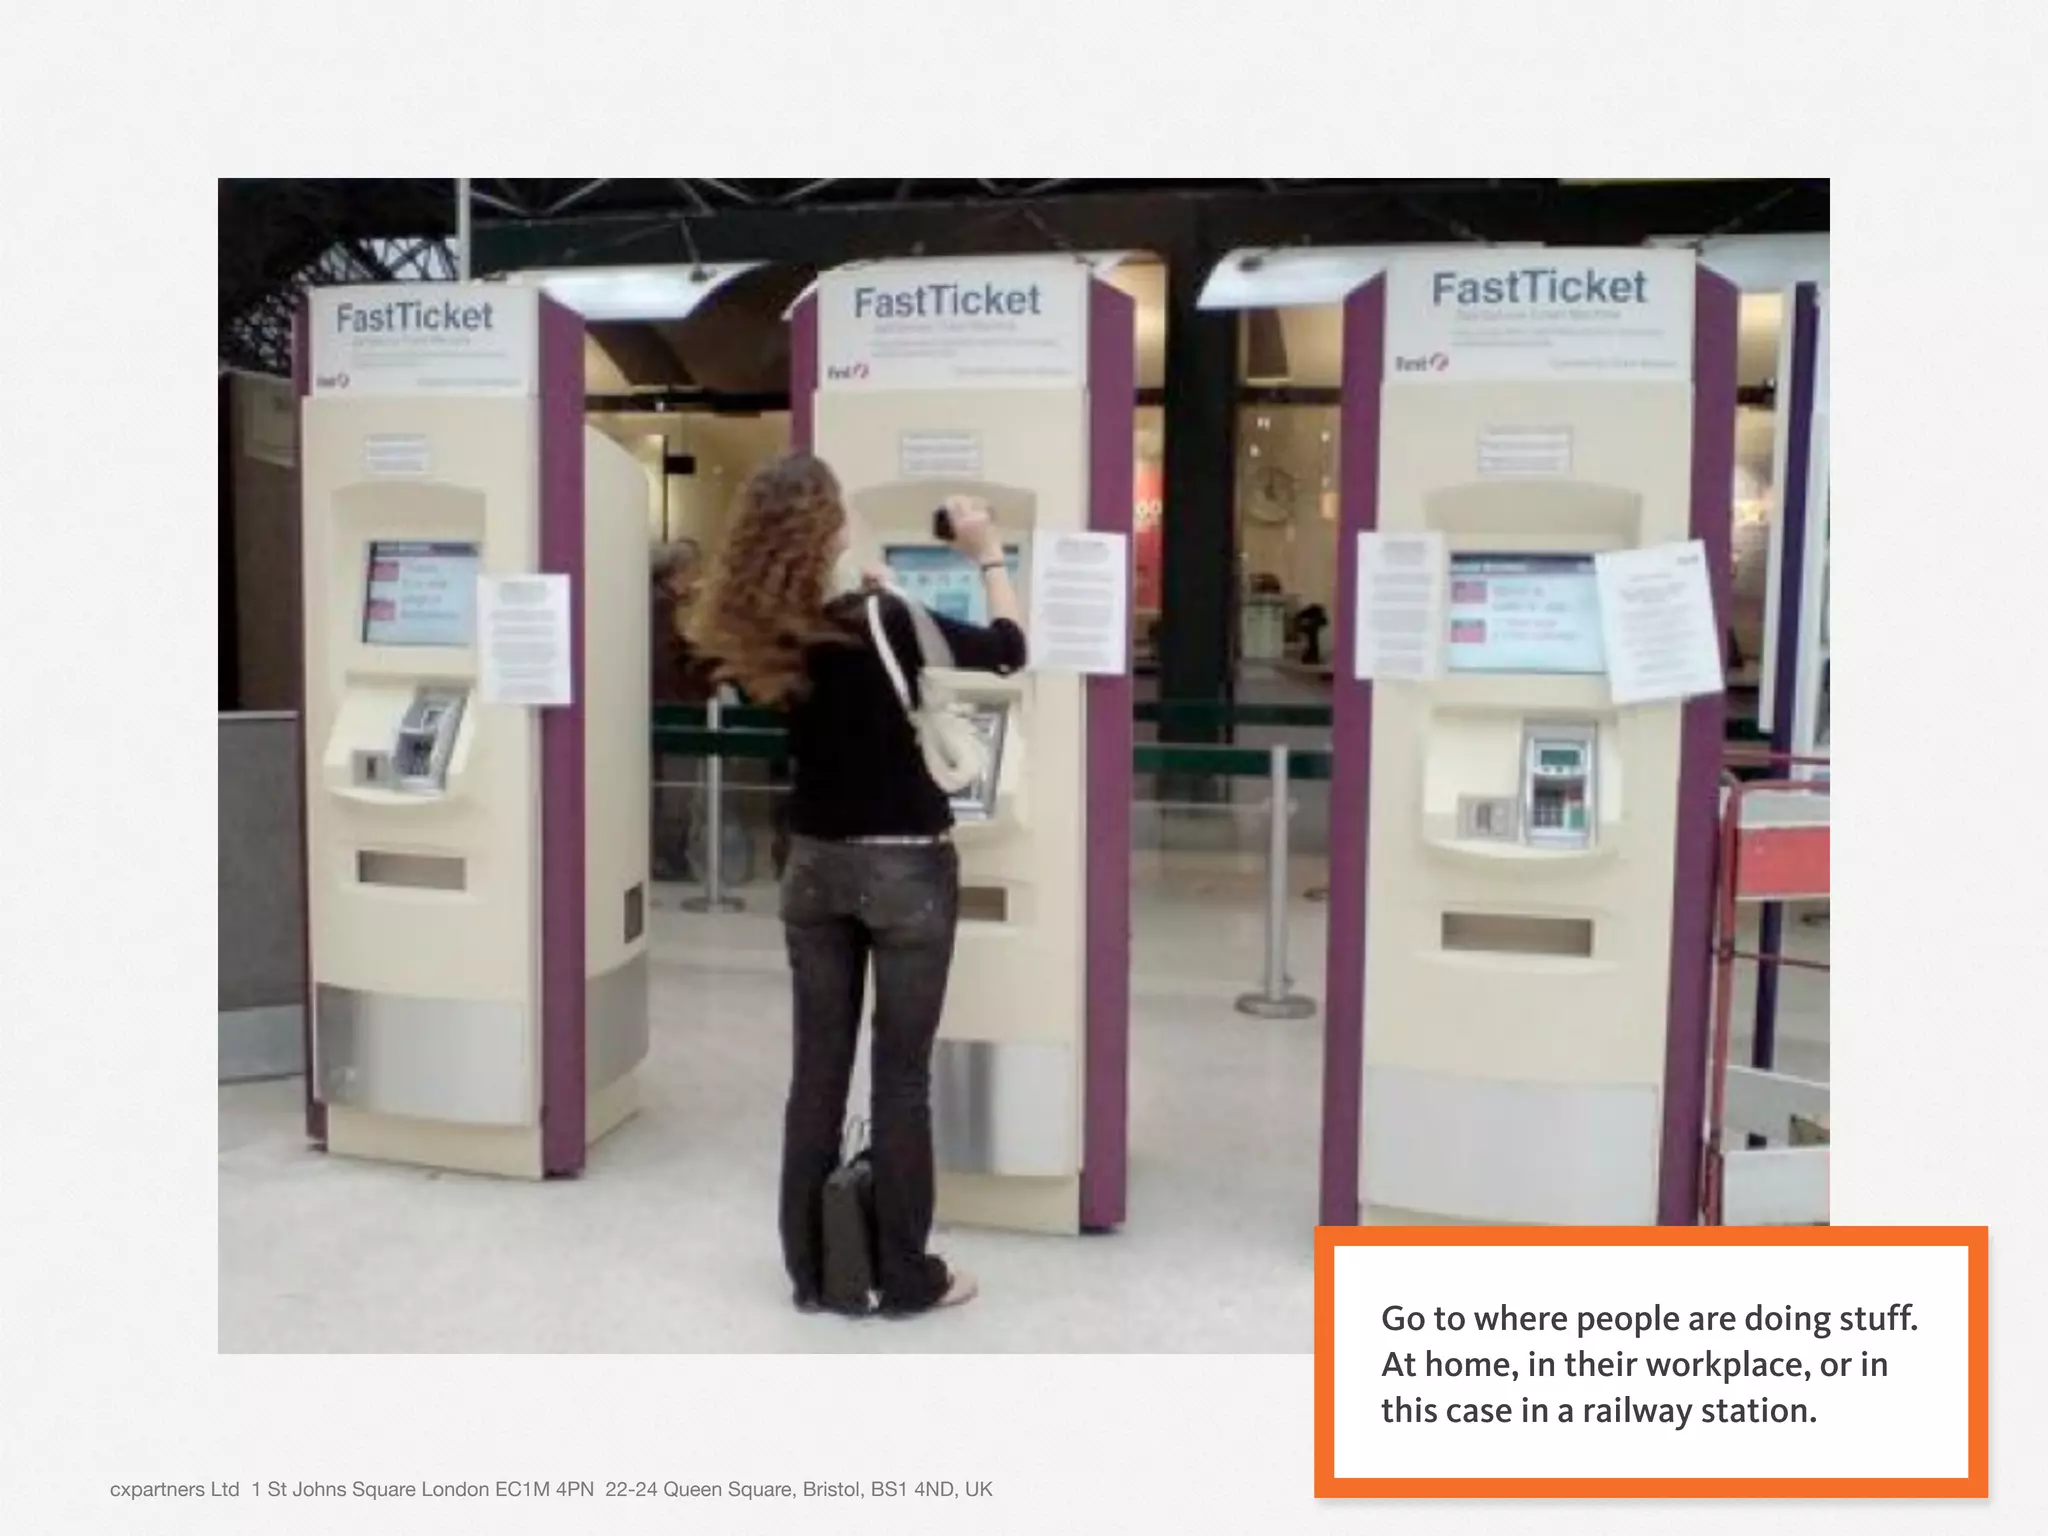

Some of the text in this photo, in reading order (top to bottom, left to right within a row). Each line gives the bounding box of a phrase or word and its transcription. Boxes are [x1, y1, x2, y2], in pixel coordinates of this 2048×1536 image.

[853, 282, 1042, 319] FastTicket
[1431, 268, 1648, 306] FastTicket
[336, 301, 495, 334] FastTicket
